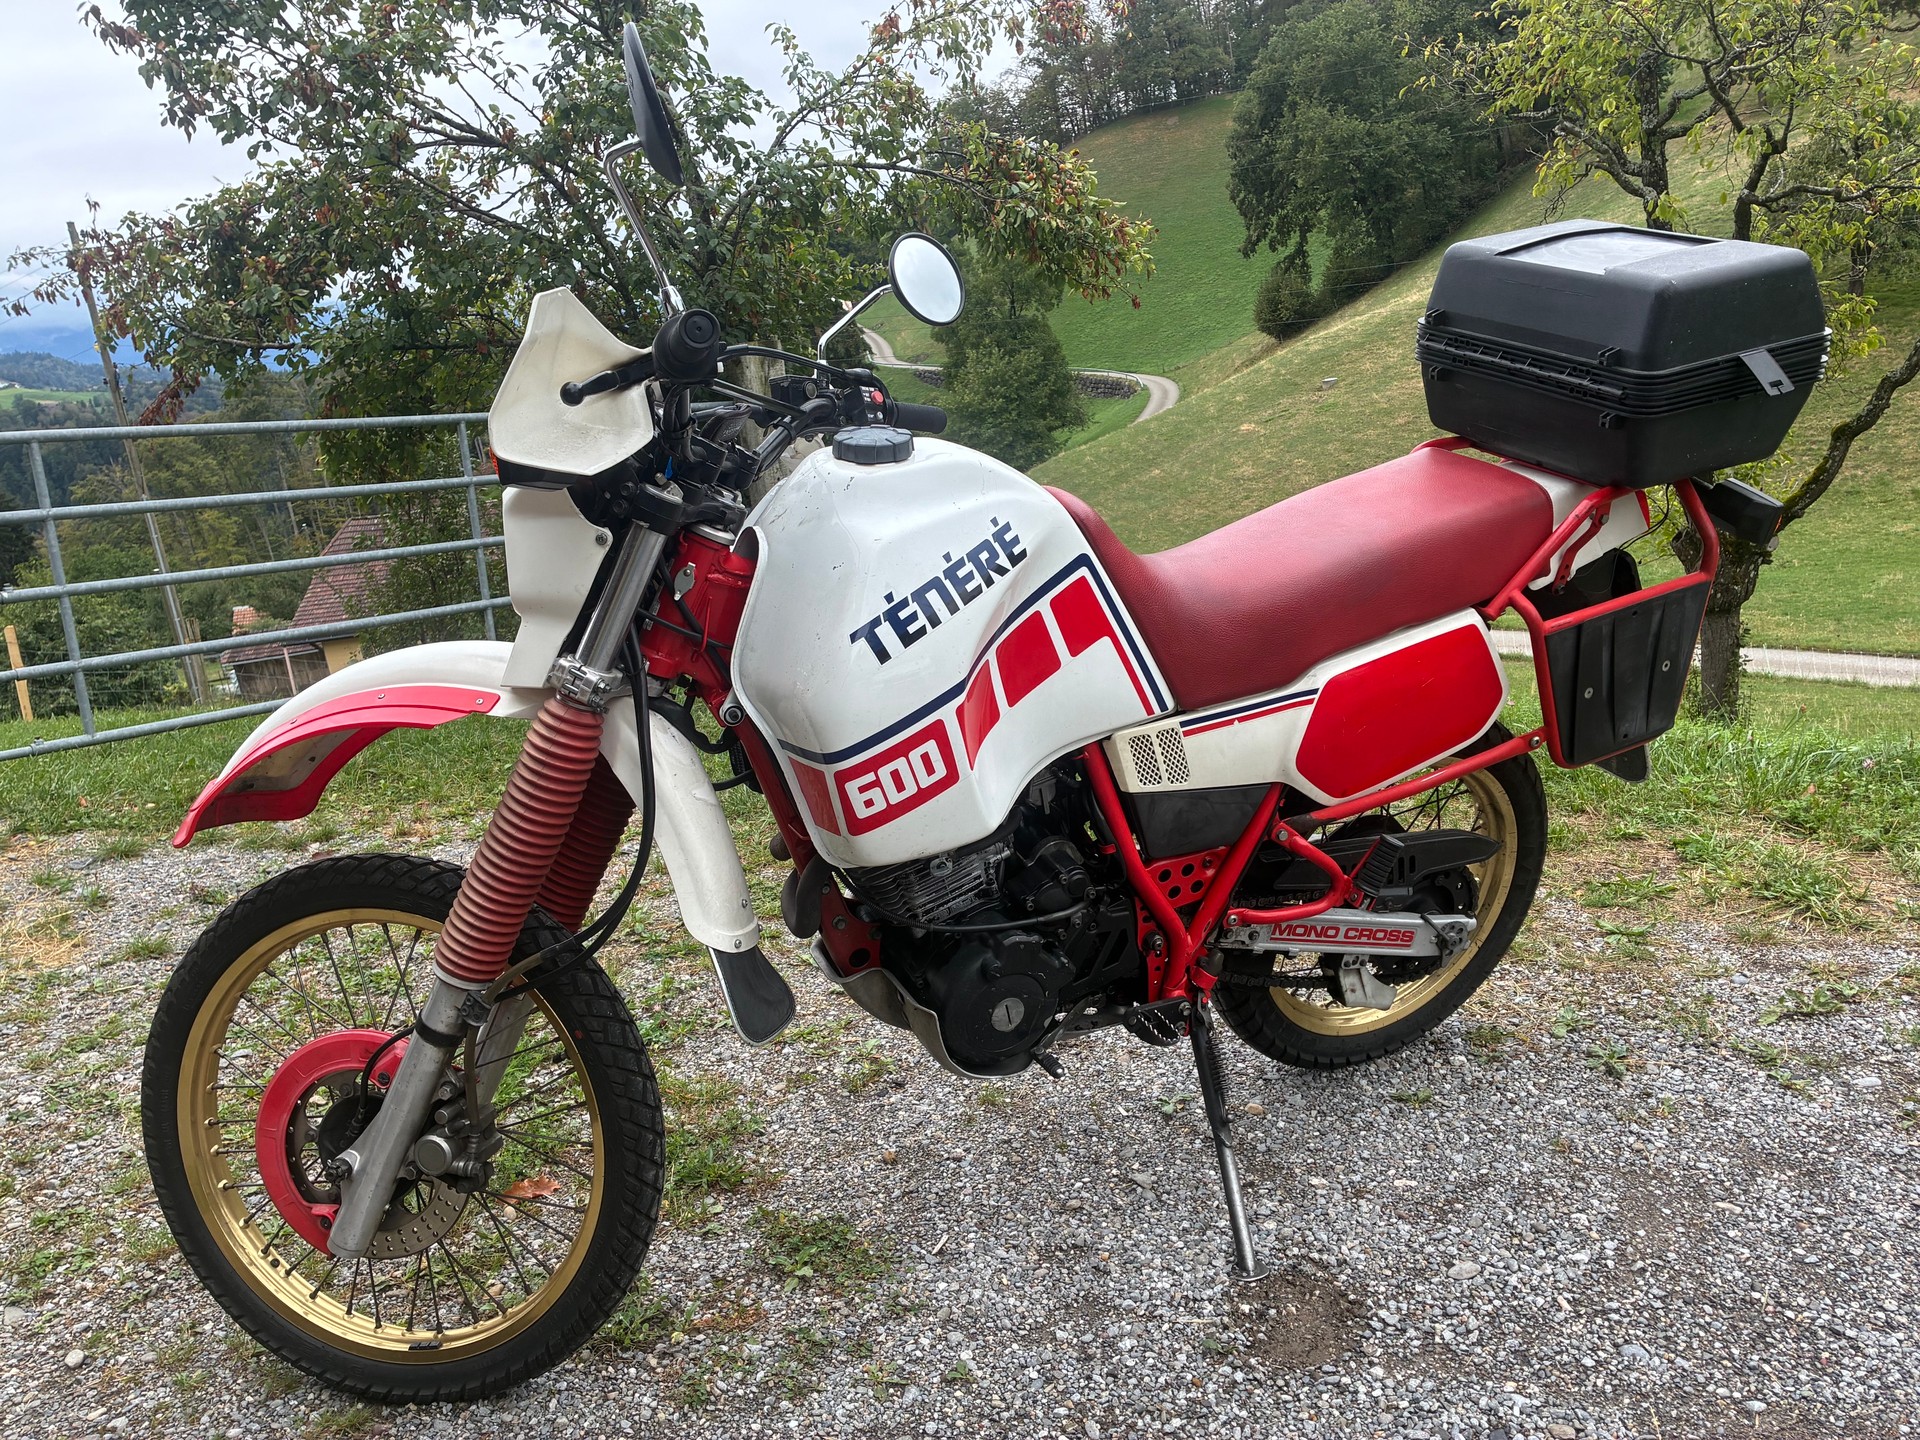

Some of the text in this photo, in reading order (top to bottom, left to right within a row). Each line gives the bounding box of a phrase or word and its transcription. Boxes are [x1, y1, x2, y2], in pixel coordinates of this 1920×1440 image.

[845, 740, 947, 819] 600
[1272, 924, 1414, 943] MONO CROSS
